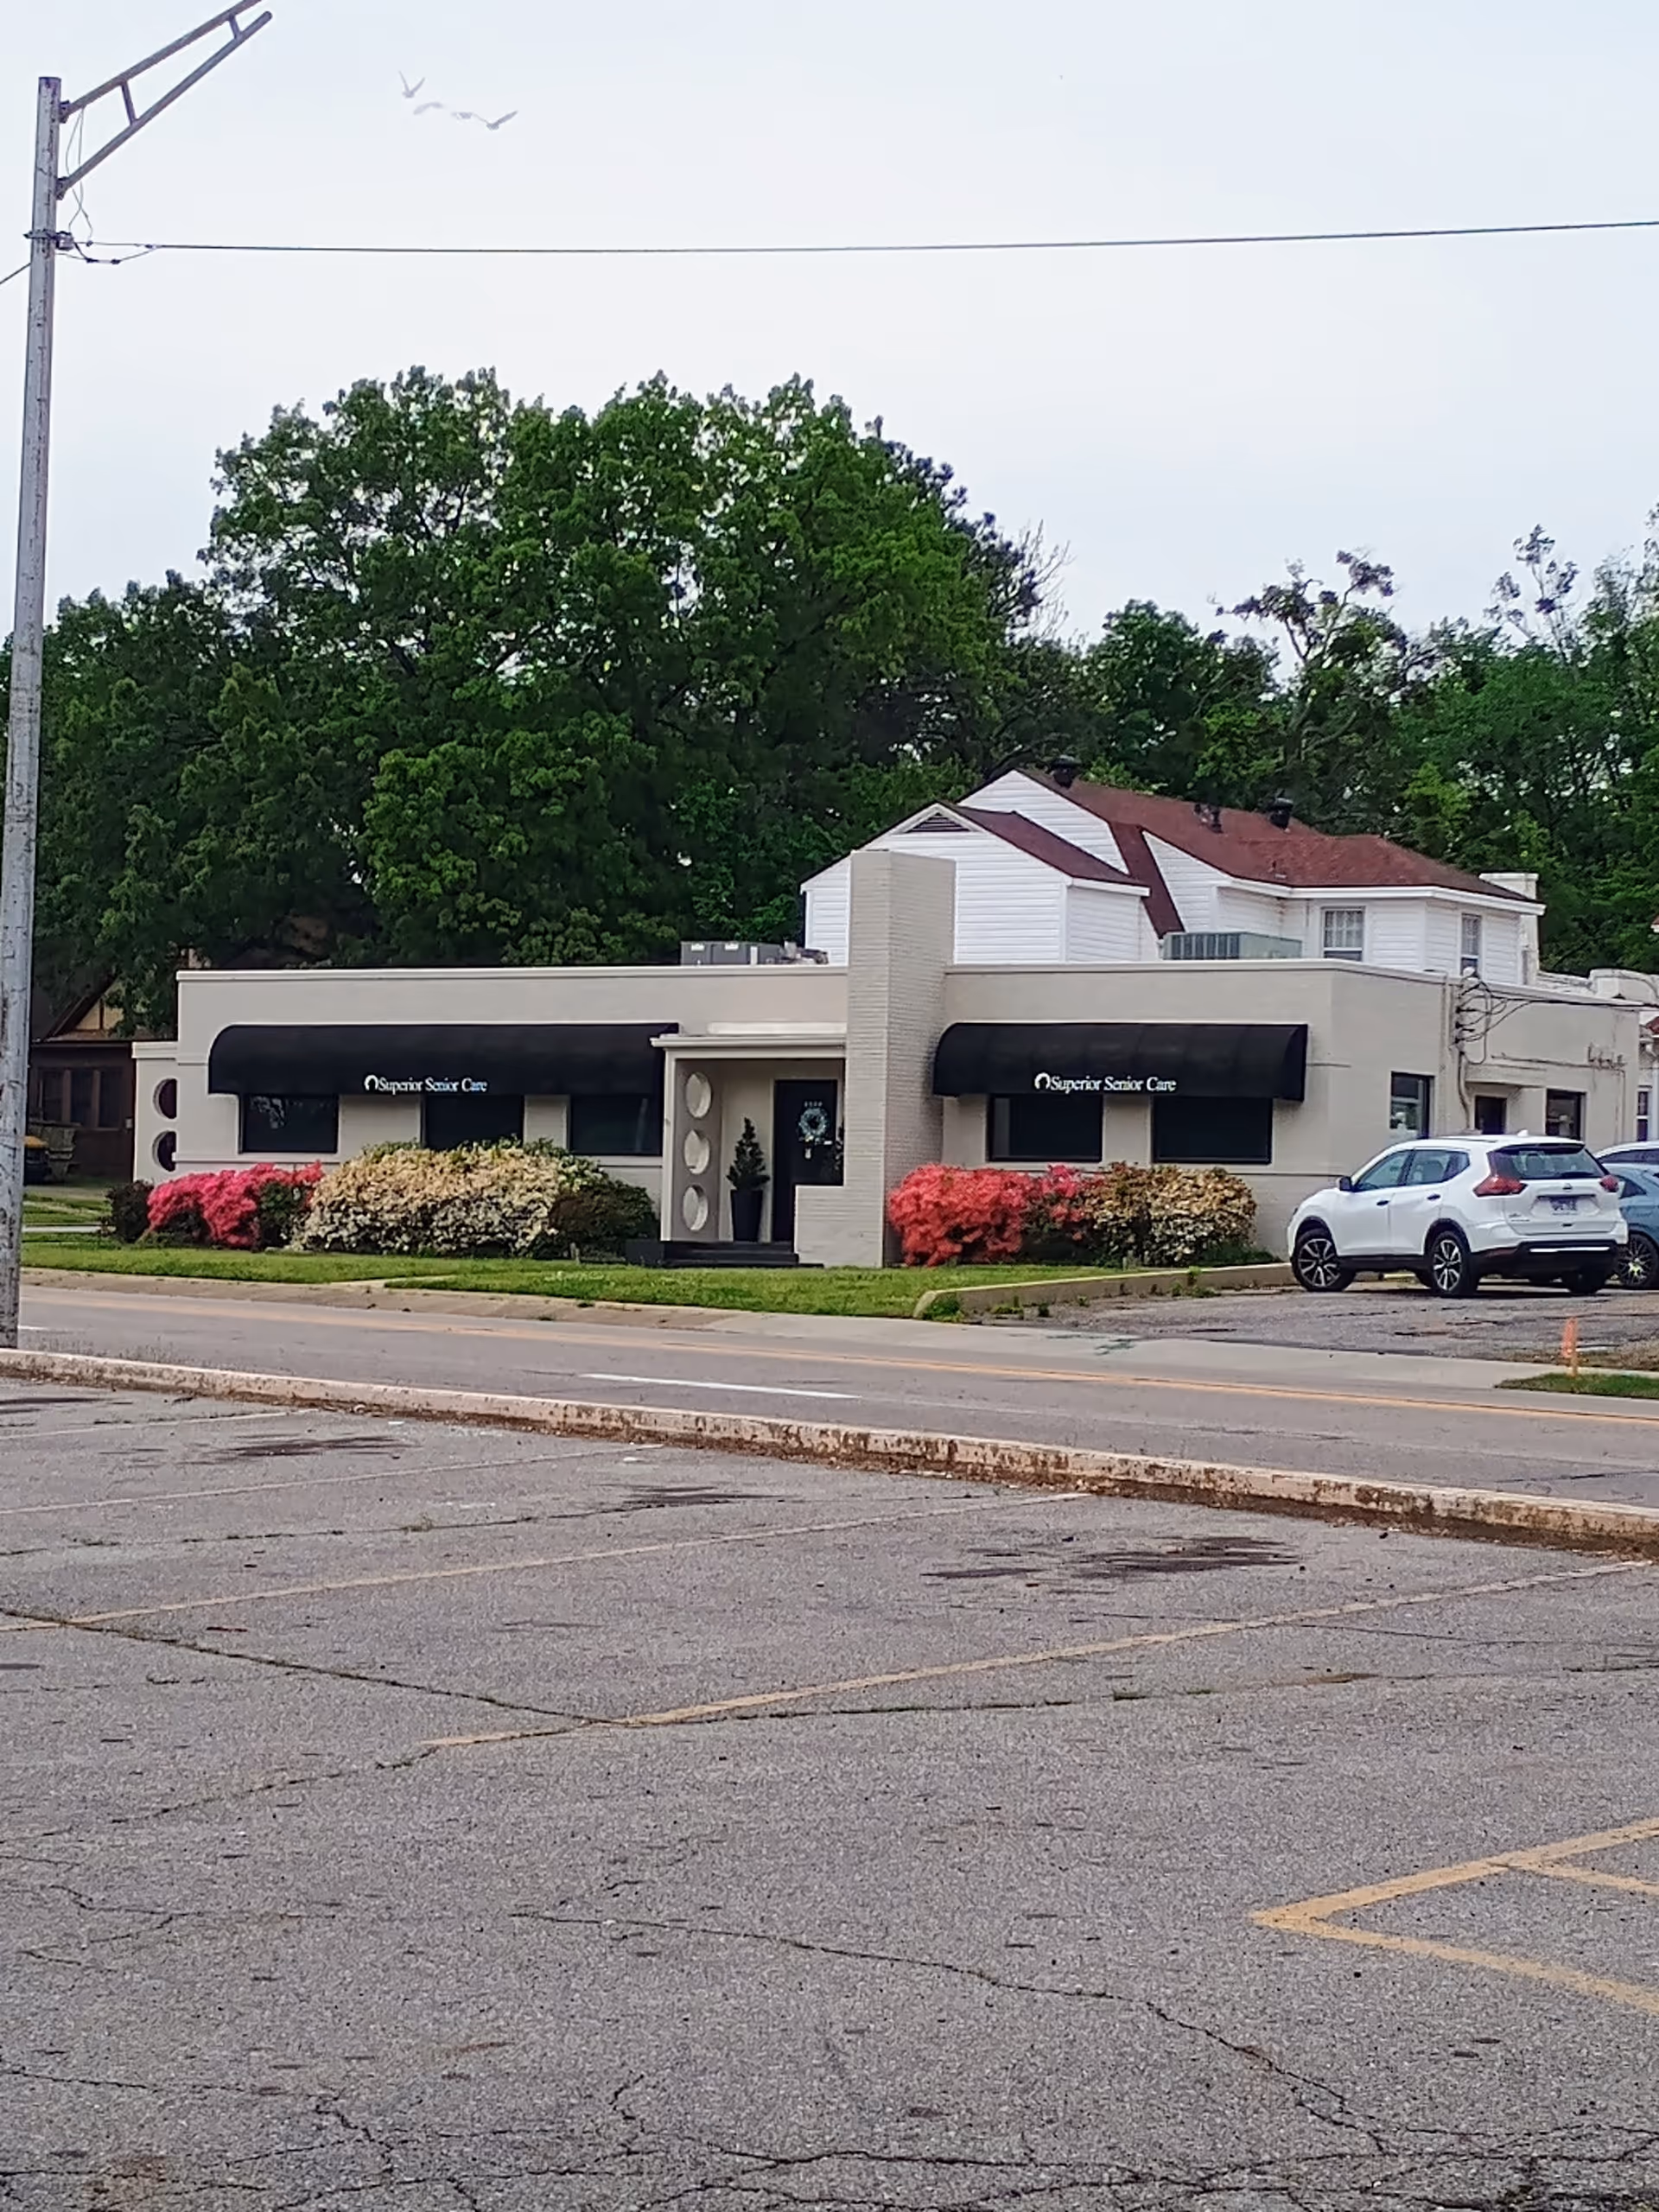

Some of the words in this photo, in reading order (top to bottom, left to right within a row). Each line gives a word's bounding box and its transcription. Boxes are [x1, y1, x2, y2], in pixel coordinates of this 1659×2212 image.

[378, 1077, 423, 1095] Superior
[424, 1077, 459, 1092] Senior
[461, 1077, 487, 1092] Care
[1050, 1076, 1102, 1094] Superior
[1103, 1076, 1143, 1091] Senior
[1147, 1077, 1177, 1091] Care
